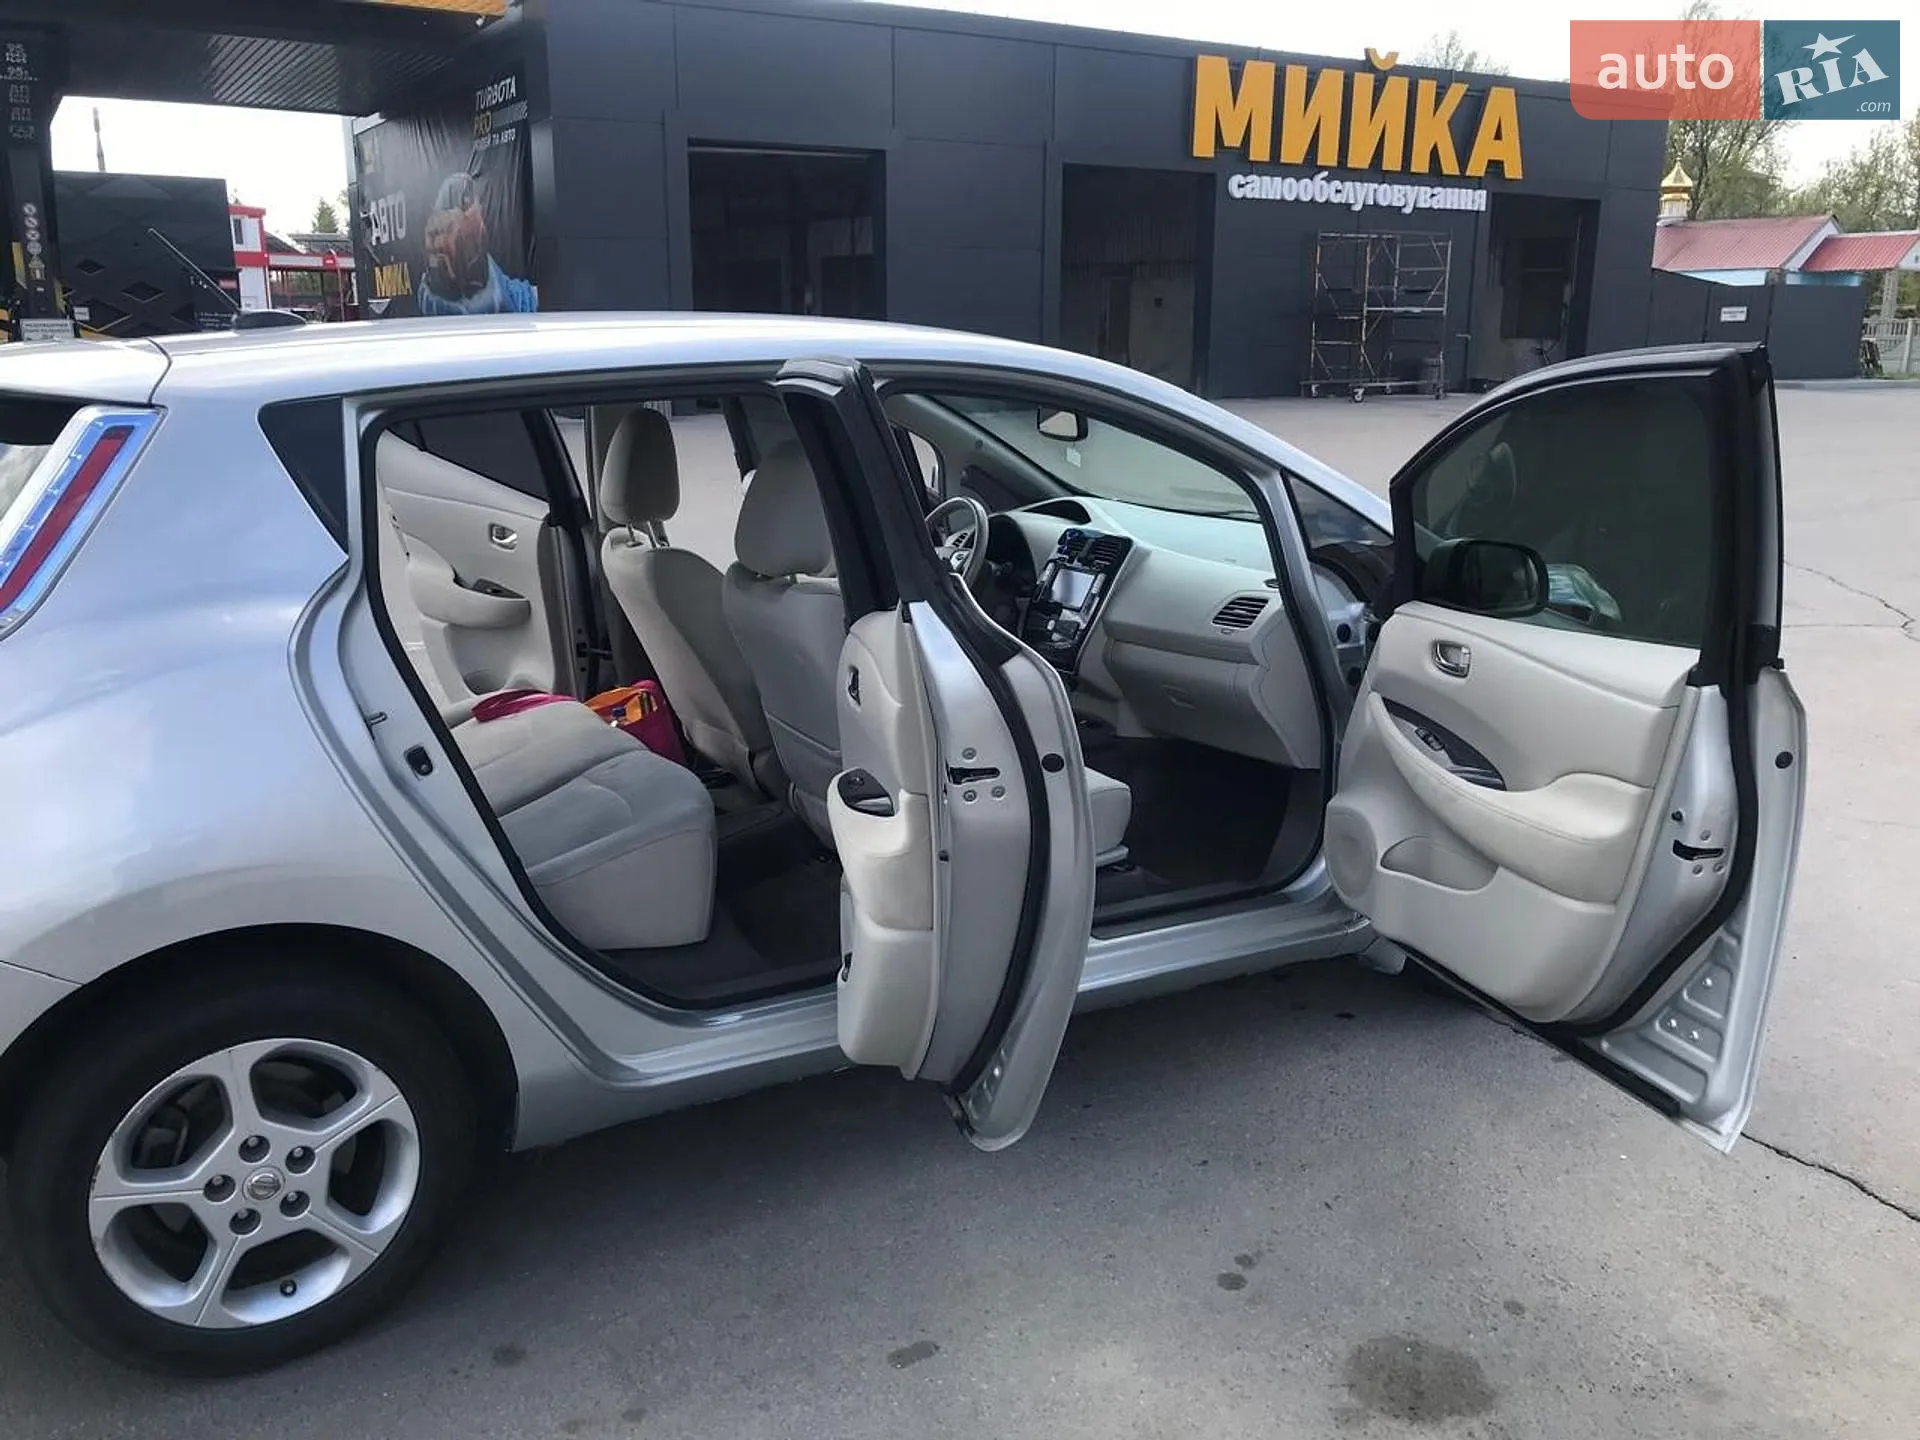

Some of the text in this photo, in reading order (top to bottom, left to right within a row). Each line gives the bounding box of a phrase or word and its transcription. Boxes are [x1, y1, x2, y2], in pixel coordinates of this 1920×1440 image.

[1192, 48, 1523, 180] МИЙКА
[370, 191, 407, 246] АВТО
[1228, 171, 1487, 214] самообслуговування
